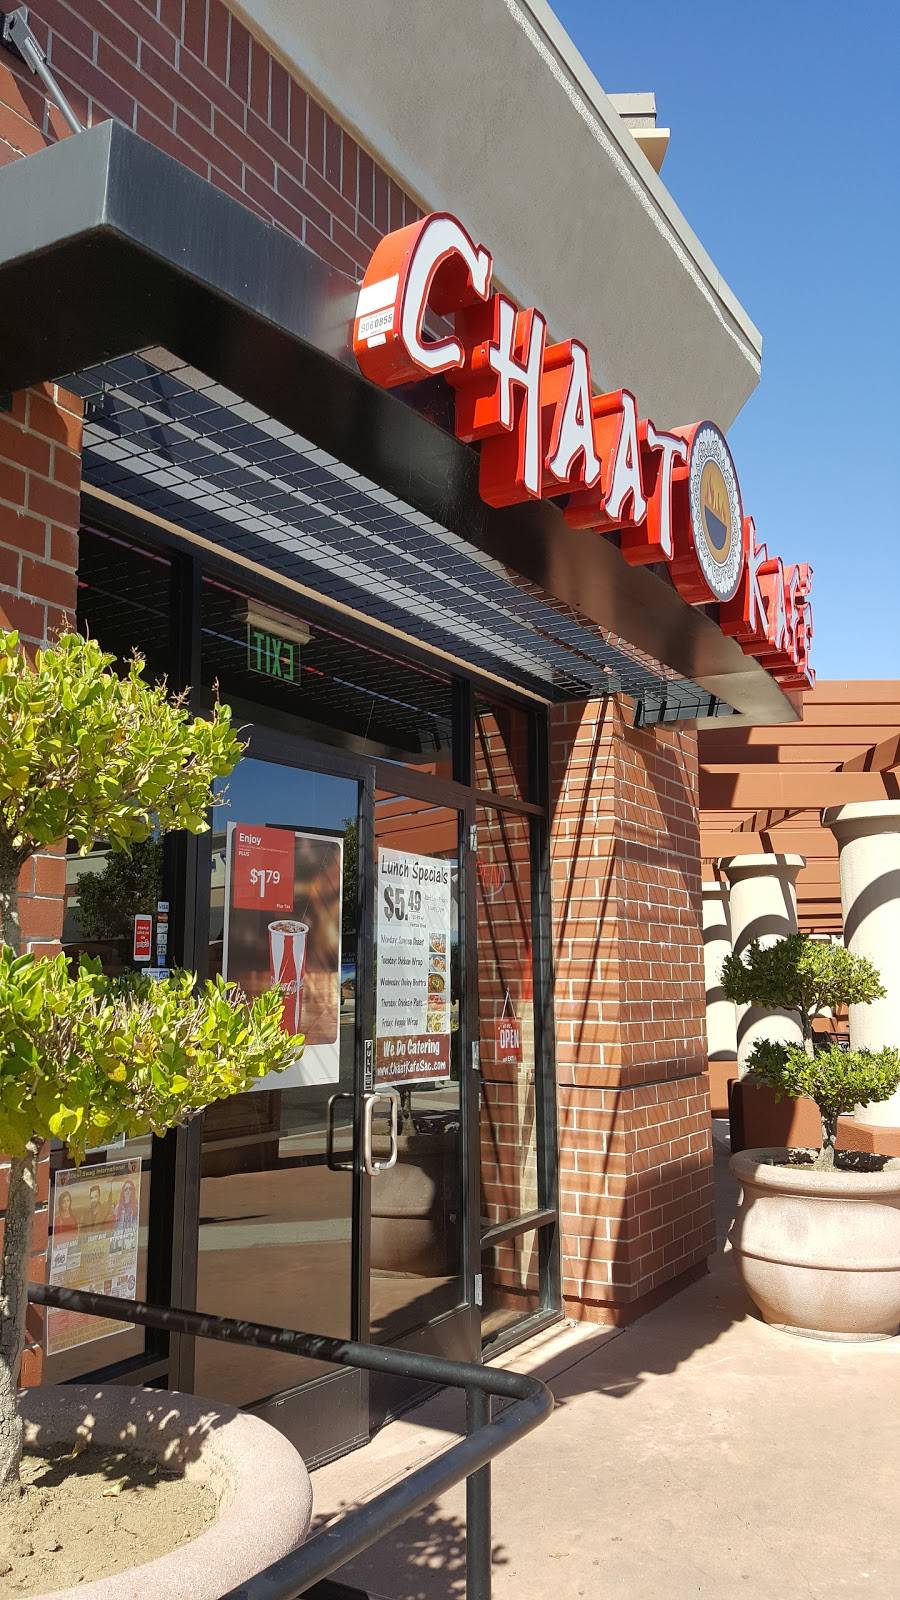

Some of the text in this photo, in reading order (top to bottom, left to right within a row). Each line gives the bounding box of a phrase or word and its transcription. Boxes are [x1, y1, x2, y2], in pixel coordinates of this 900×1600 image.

[398, 210, 689, 562] CHAAT
[239, 832, 262, 846] Enjoy
[381, 855, 409, 878] Lunch
[412, 861, 449, 886] Specials
[383, 1038, 440, 1058] We Do Catering
[500, 1029, 519, 1049] OPEN
[376, 1060, 446, 1076] www.ChaatKafeSac.com
